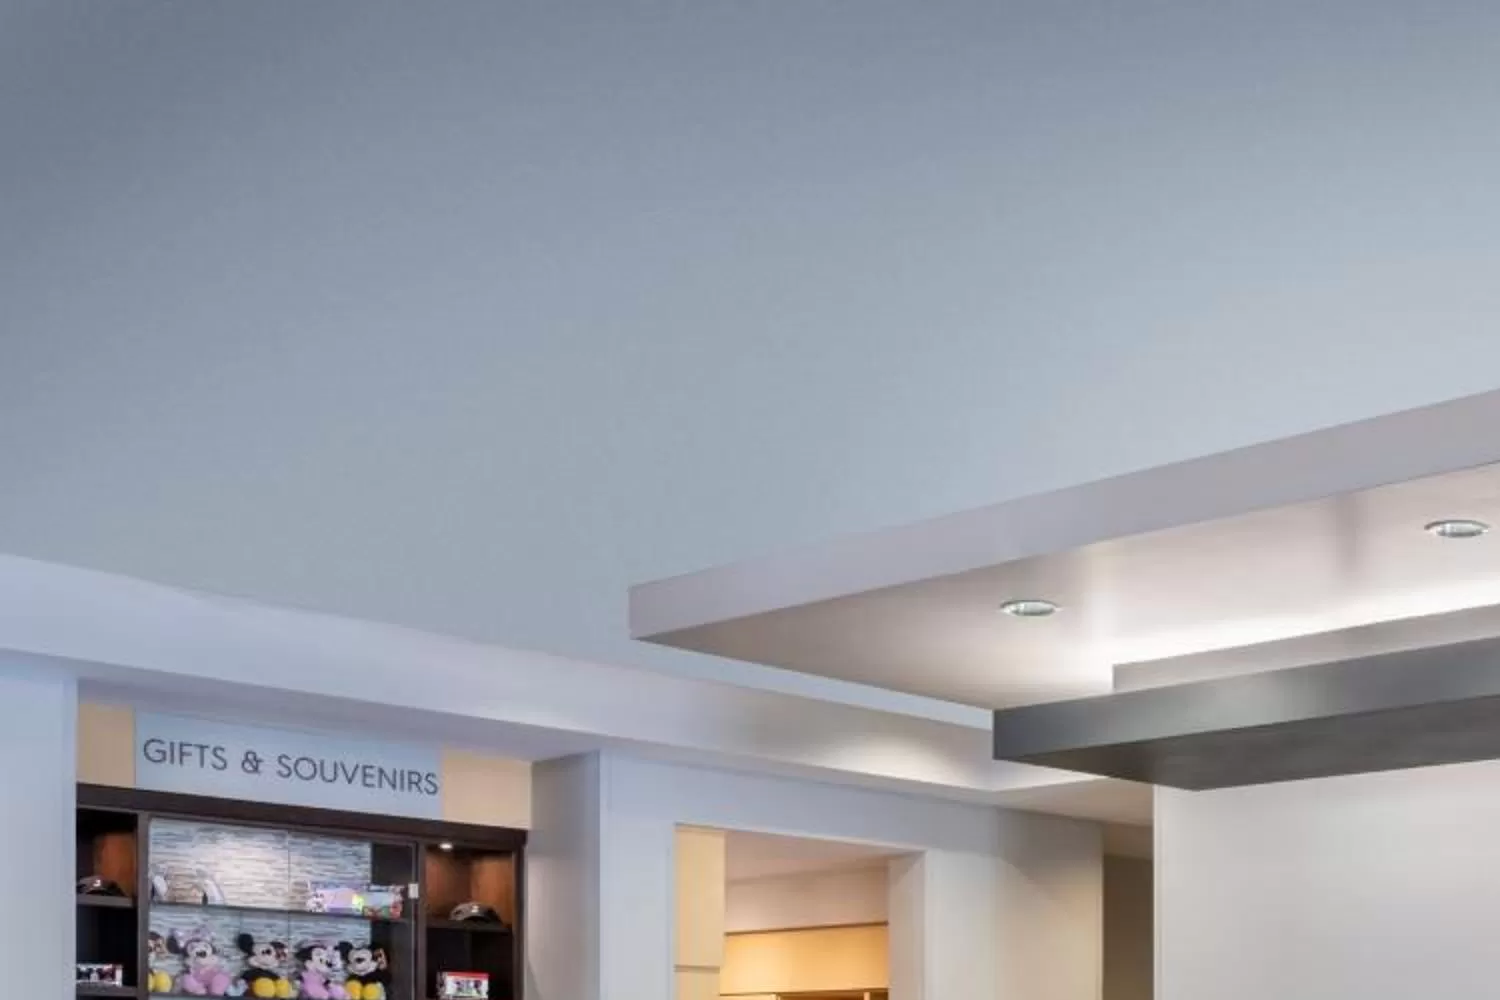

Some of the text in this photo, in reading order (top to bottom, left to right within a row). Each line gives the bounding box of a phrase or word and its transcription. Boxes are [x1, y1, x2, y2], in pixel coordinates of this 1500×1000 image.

[143, 738, 439, 796] GIFTS & SOUVENIRS
